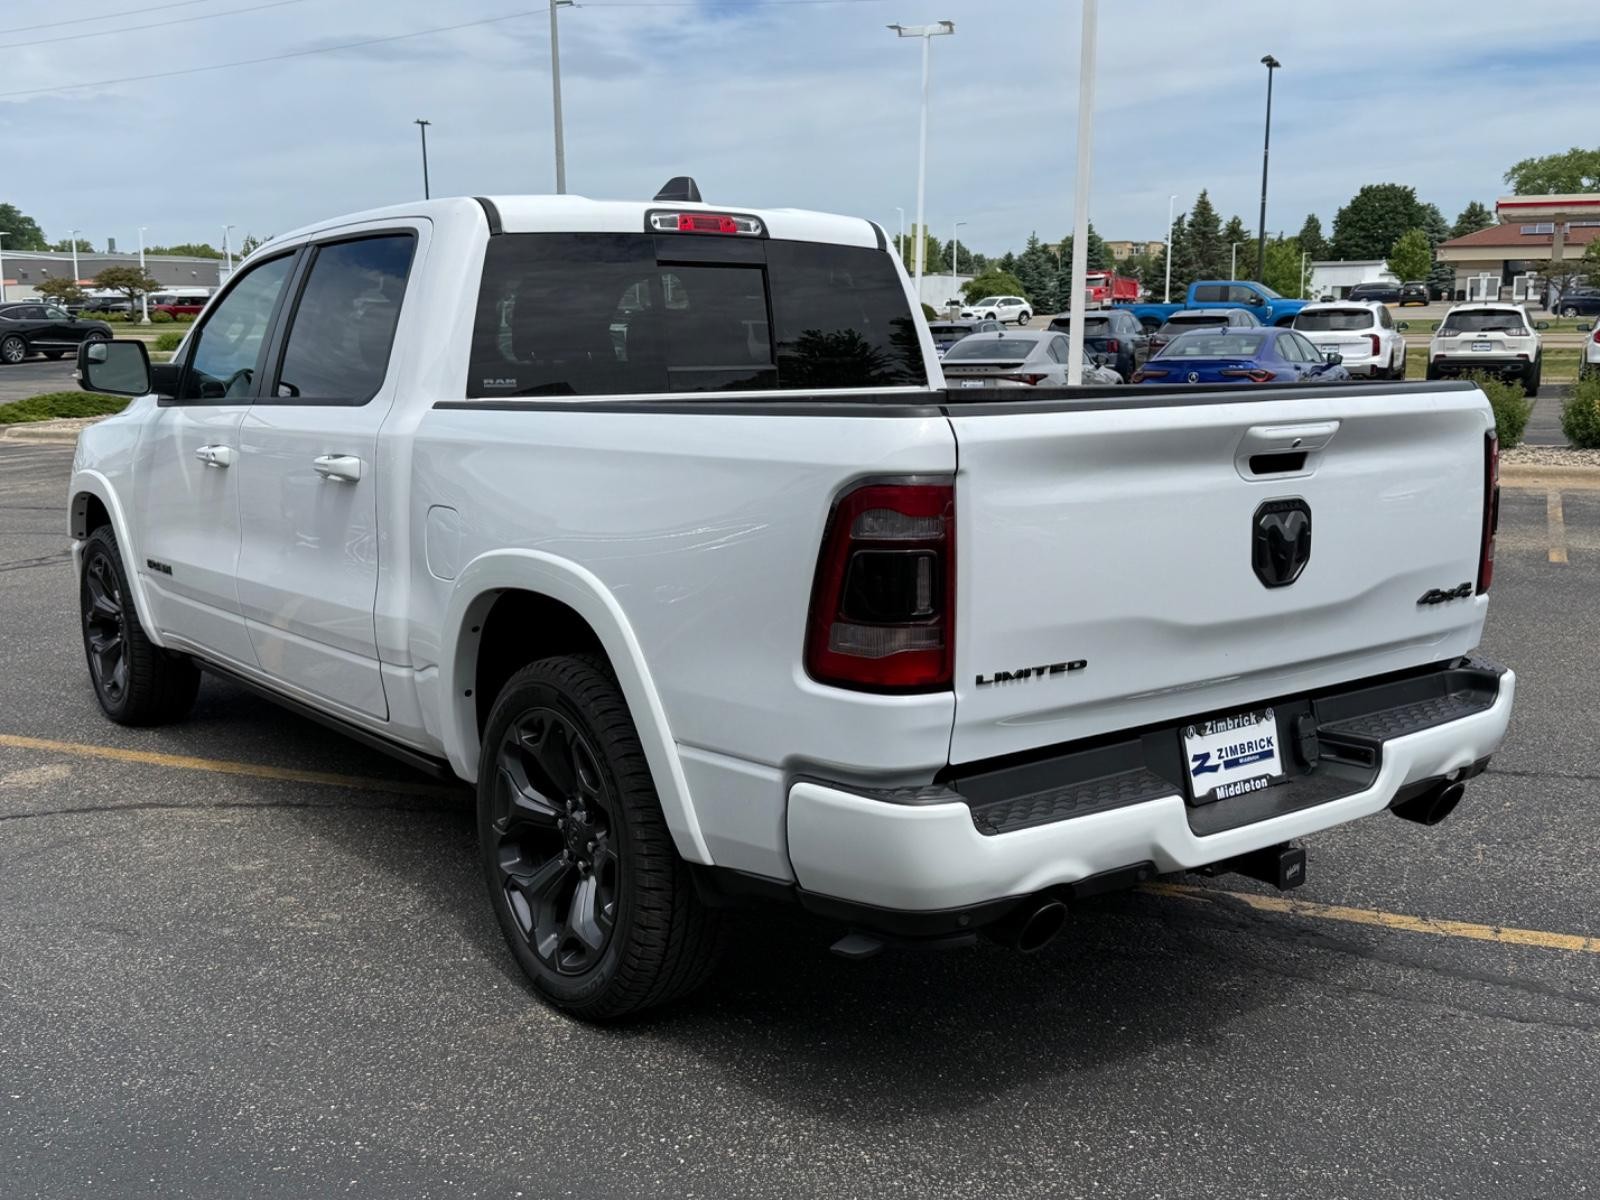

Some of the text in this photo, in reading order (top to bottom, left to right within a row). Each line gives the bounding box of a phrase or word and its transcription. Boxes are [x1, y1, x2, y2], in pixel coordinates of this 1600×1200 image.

[975, 659, 1088, 685] LIMITED
[1204, 712, 1257, 735] Zimbrick
[1216, 736, 1275, 760] ZIMBRICK
[1215, 778, 1268, 800] Middleton
